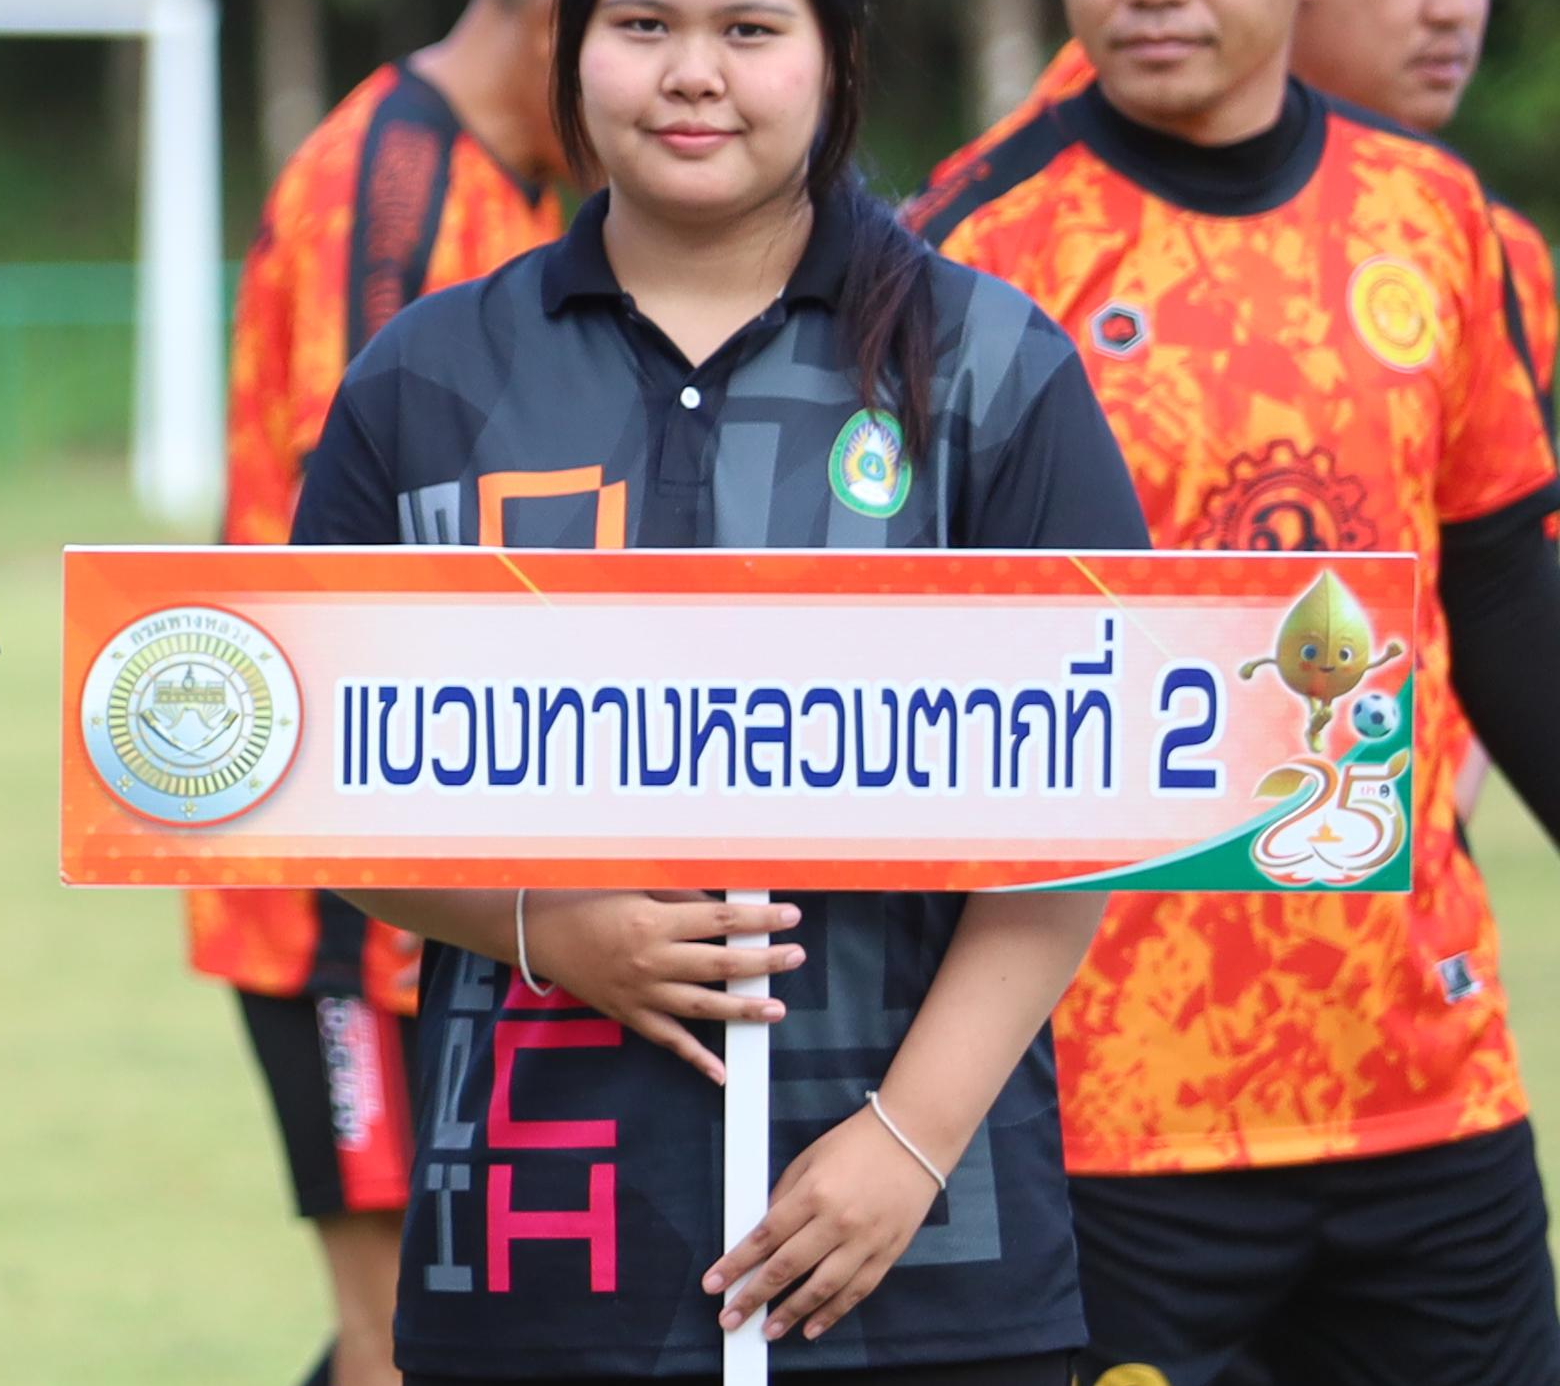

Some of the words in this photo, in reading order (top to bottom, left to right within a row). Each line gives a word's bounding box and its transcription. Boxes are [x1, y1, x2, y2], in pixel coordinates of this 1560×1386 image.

[342, 619, 1112, 790] แขวงทางหลวงตากที่
[1158, 669, 1220, 790] 2
